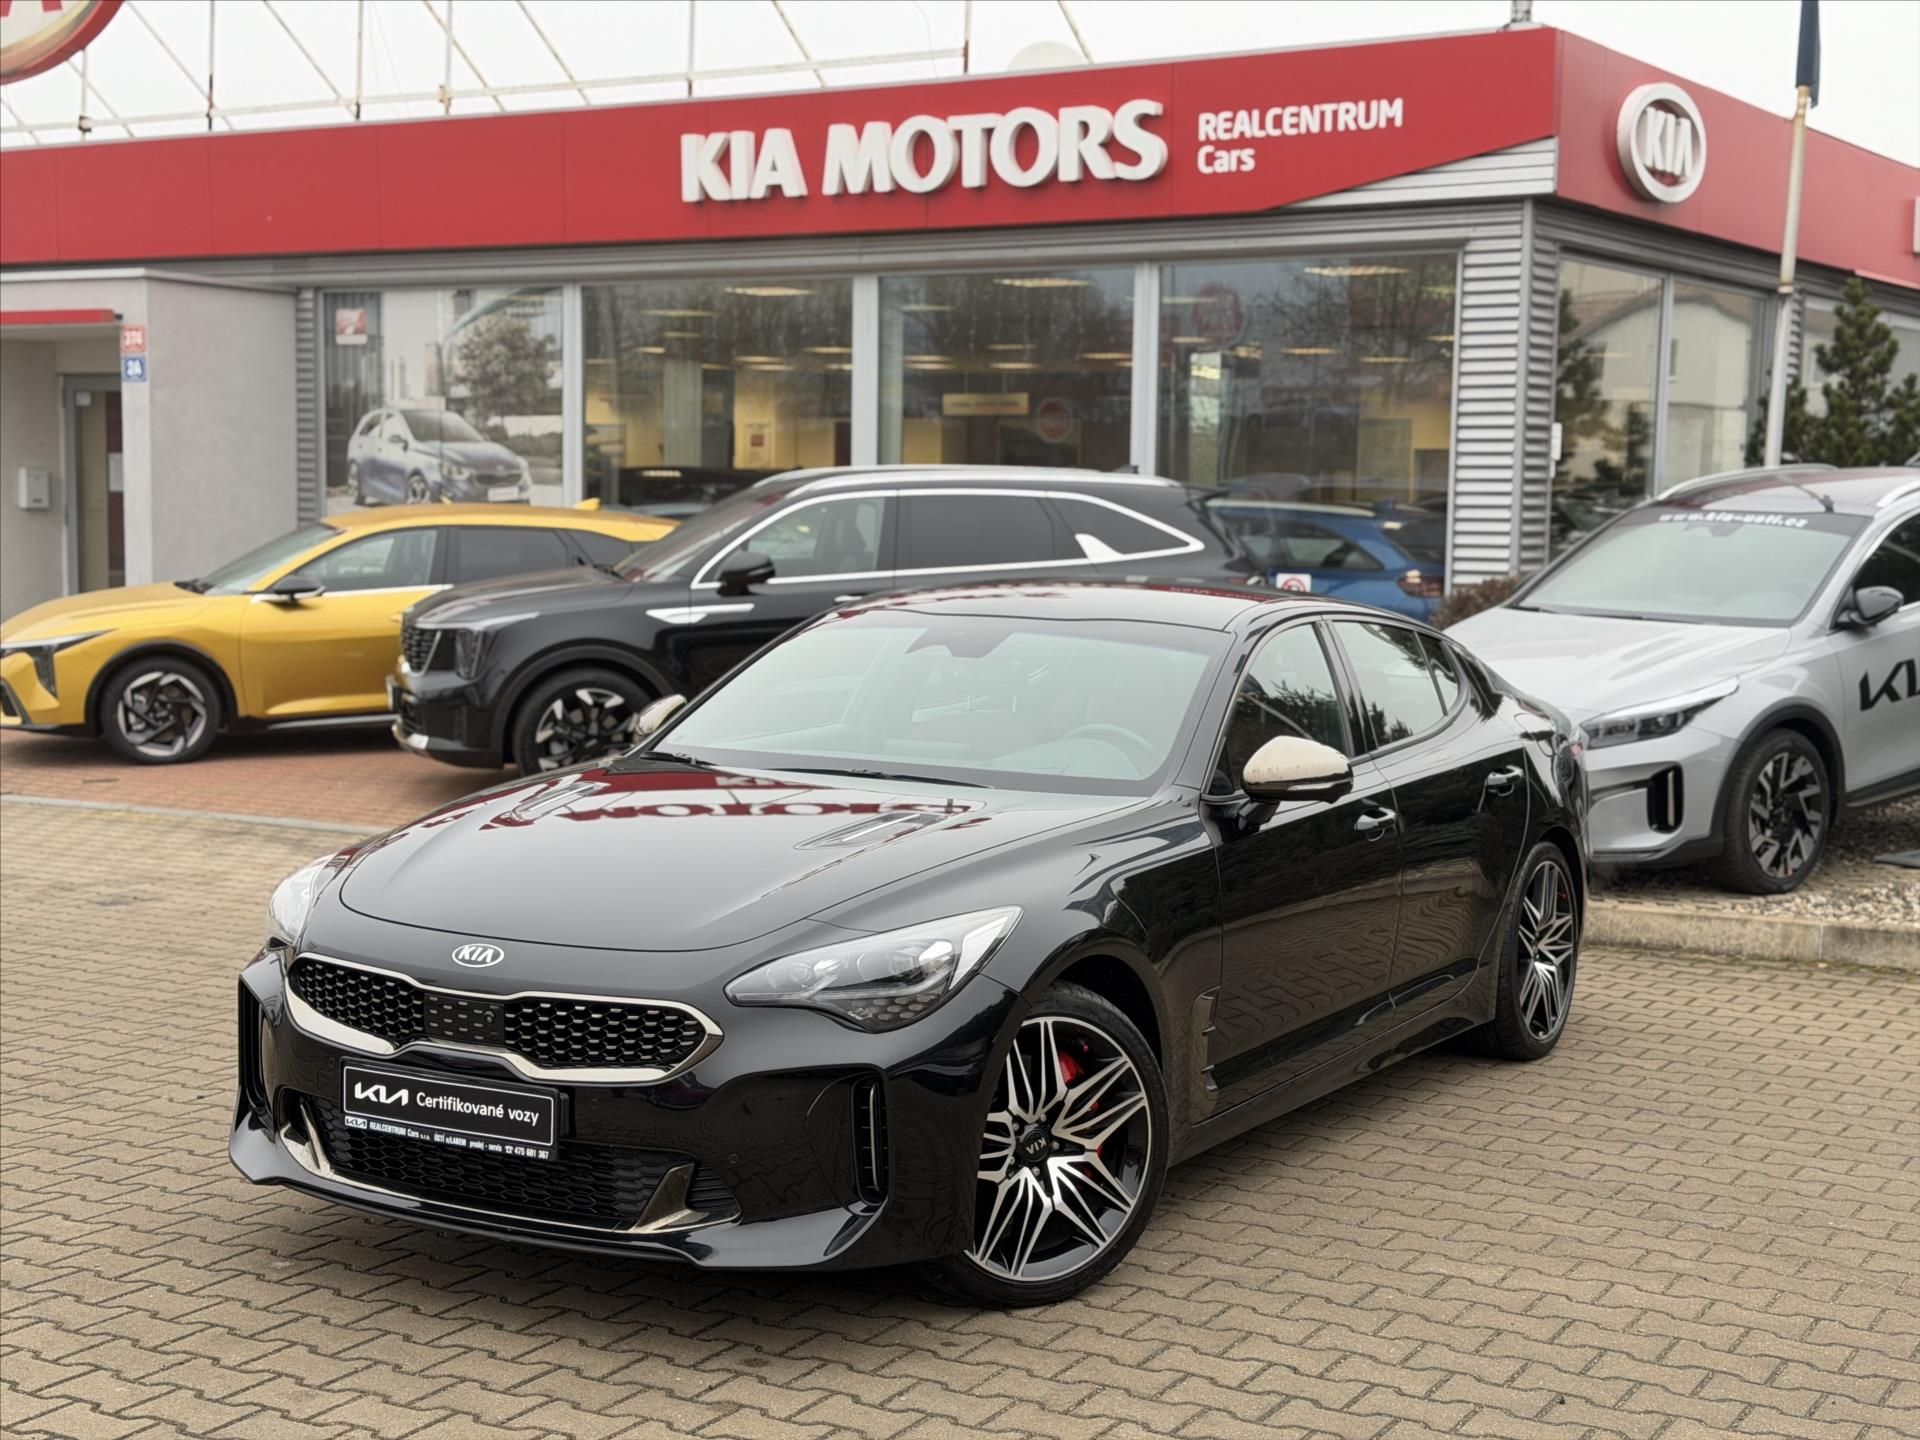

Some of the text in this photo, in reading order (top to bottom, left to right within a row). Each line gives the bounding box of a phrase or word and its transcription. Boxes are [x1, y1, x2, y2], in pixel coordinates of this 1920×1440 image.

[1198, 97, 1404, 142] REALCENTRUM
[681, 98, 1168, 203] KIA MOTORS
[1197, 145, 1256, 174] Cars
[1859, 658, 1920, 712] KI
[354, 1081, 539, 1127] KIA Certifikované vozy
[369, 1121, 406, 1136] REALCENTRUM
[407, 1128, 419, 1139] Cars
[514, 1147, 525, 1156] 475
[1025, 1137, 1047, 1154] KIA
